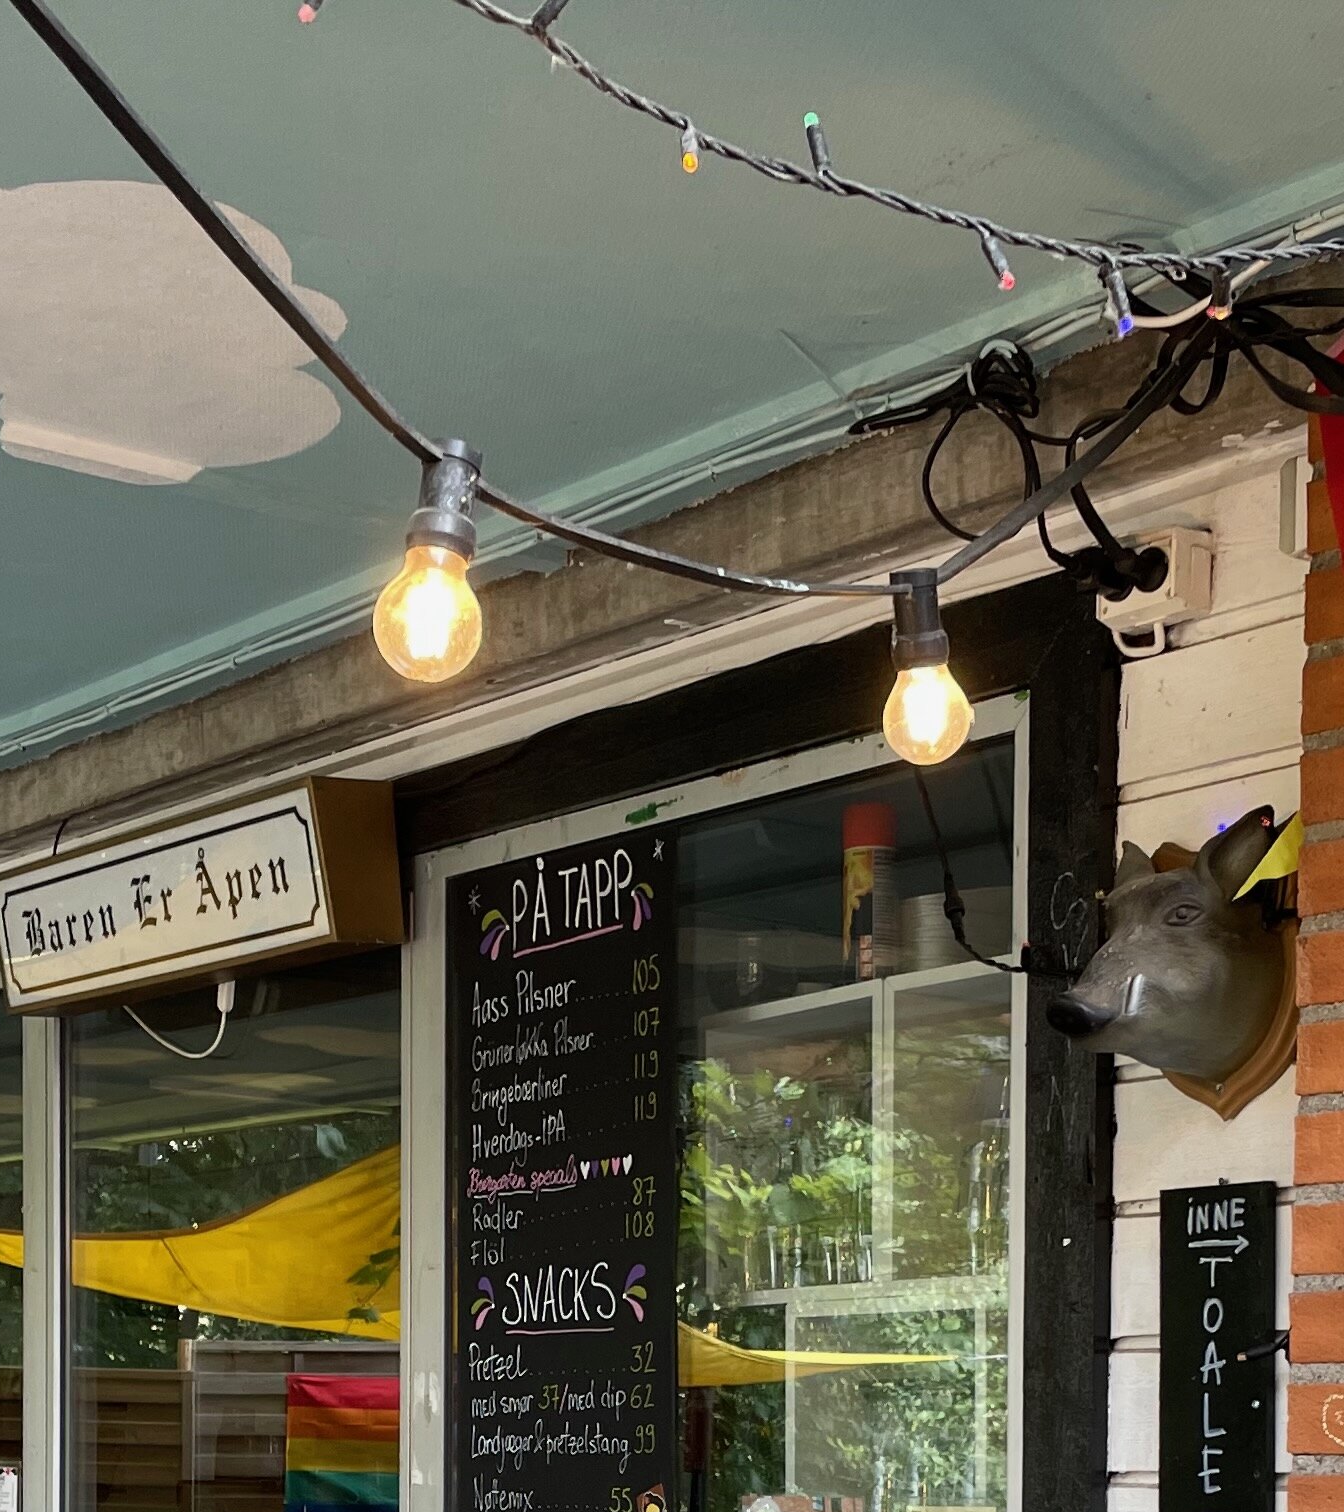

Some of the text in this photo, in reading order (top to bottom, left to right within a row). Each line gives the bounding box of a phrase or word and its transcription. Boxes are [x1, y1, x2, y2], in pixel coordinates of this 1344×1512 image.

[22, 846, 290, 957] Baren Er Åpen
[512, 848, 633, 951] PÅ TAPP
[516, 969, 577, 1016] Pilsner
[632, 953, 661, 995] 105
[553, 1015, 594, 1057] Pilsner
[633, 1006, 660, 1037] 107
[634, 1049, 660, 1080] 119
[634, 1091, 658, 1122] 119
[472, 1175, 657, 1234] Radler 87
[625, 1210, 656, 1240] 108
[1187, 1196, 1246, 1237] INNE
[501, 1261, 616, 1328] SNACKS
[468, 1341, 657, 1382] Pretzel 32
[601, 1379, 627, 1421] dip
[630, 1384, 655, 1409] 62
[634, 1423, 655, 1454] 99
